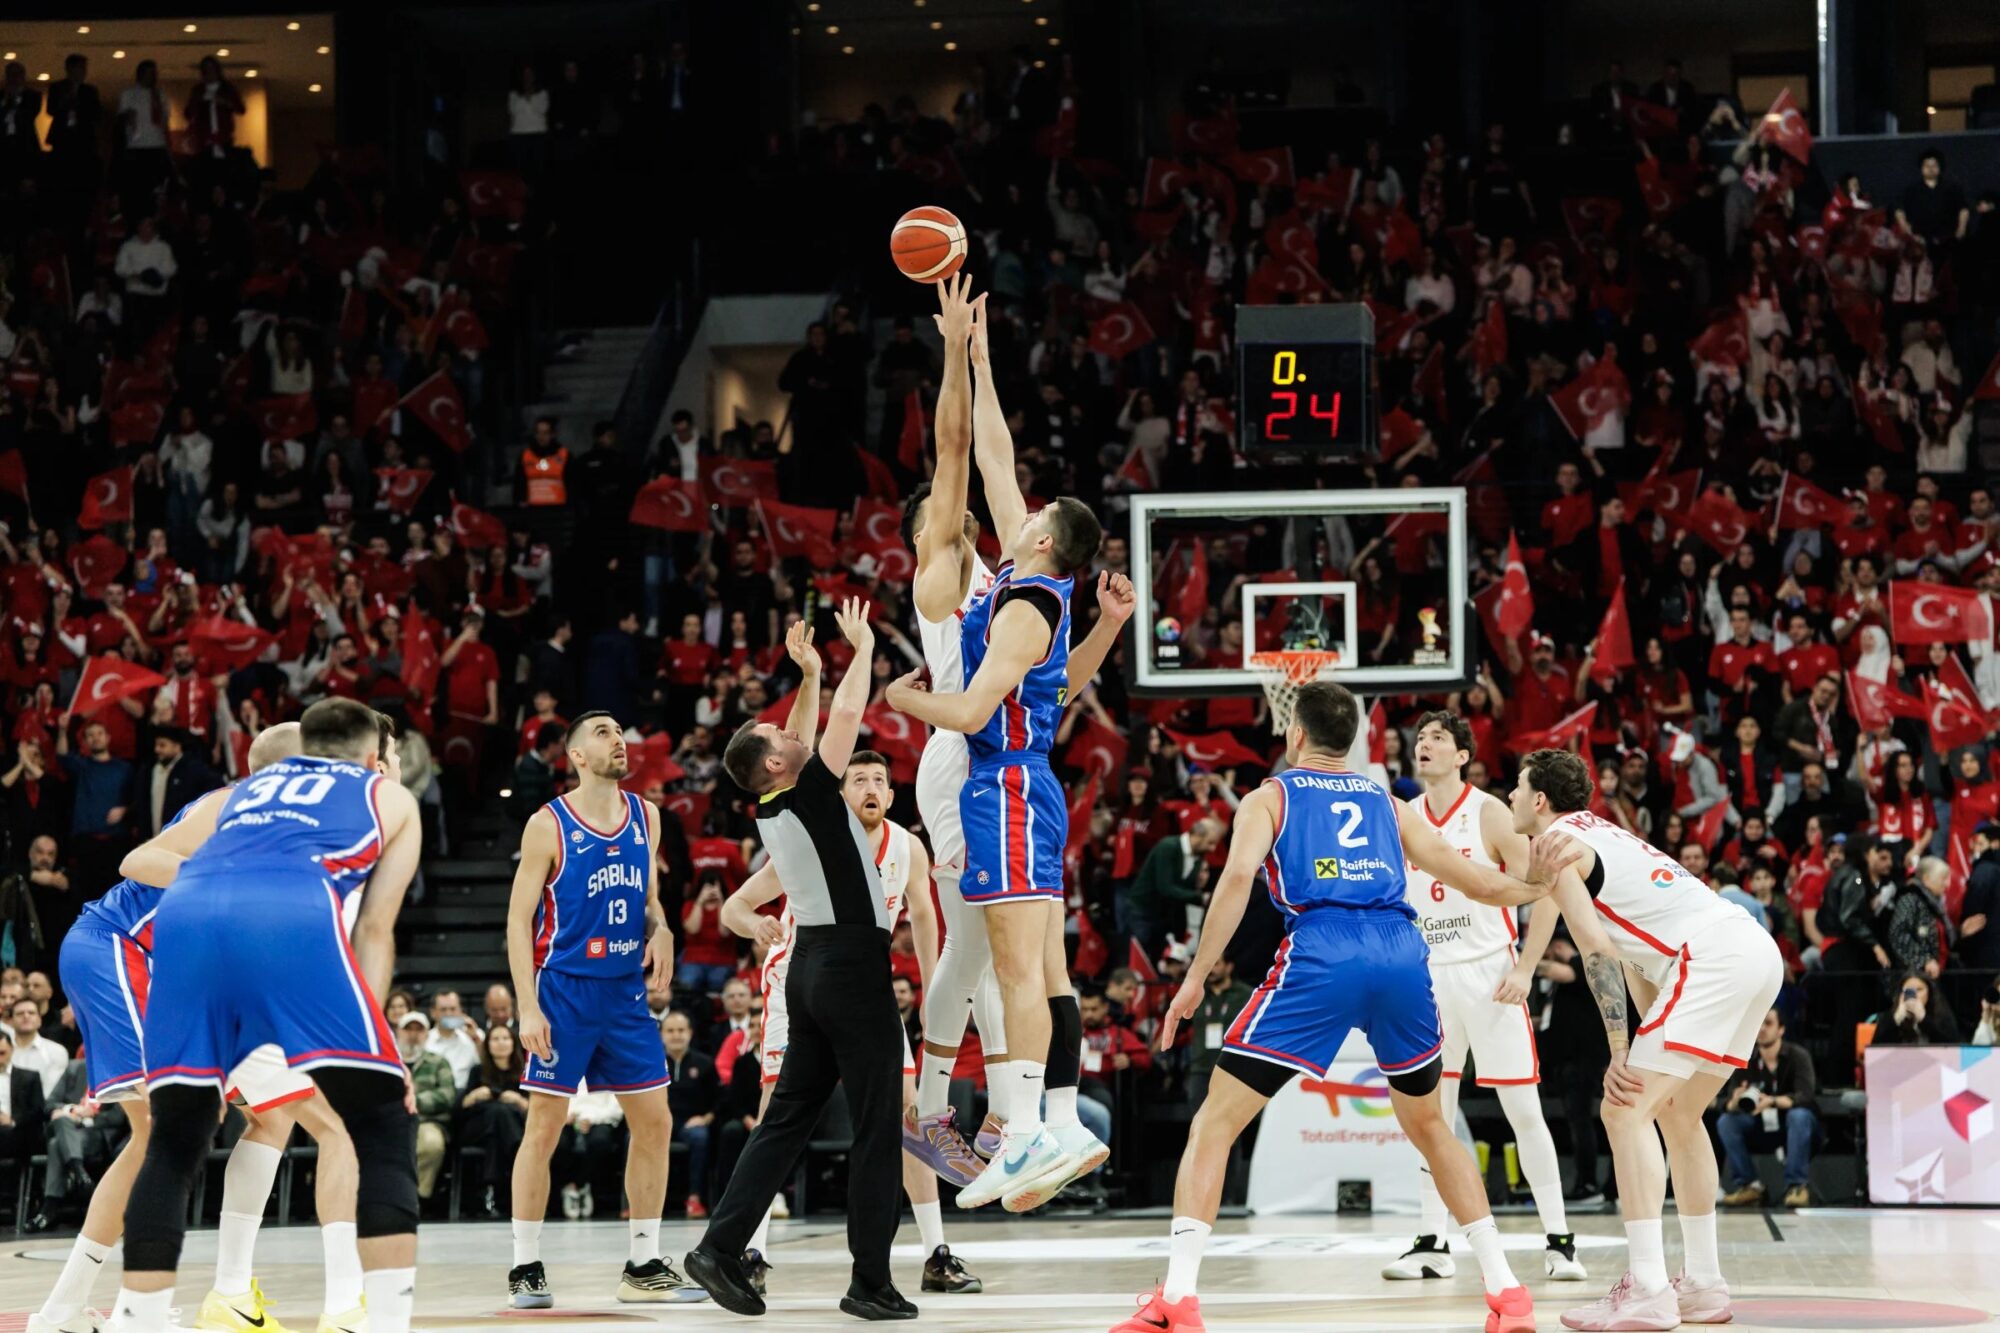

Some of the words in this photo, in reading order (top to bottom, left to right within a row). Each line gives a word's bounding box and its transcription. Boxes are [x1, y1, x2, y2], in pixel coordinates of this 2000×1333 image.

[1265, 392, 1341, 440] 24
[234, 774, 336, 812] 30
[1330, 801, 1369, 849] 2
[1340, 858, 1394, 875] Raiffeis
[1342, 870, 1374, 881] Bank
[587, 863, 643, 898] SRBIJA
[1430, 880, 1445, 902] 6
[608, 899, 627, 925] 13
[1423, 914, 1471, 931] Garanti
[1426, 930, 1461, 944] BBVA
[536, 1070, 555, 1080] mts
[1300, 1129, 1409, 1146] TotalEnergies
